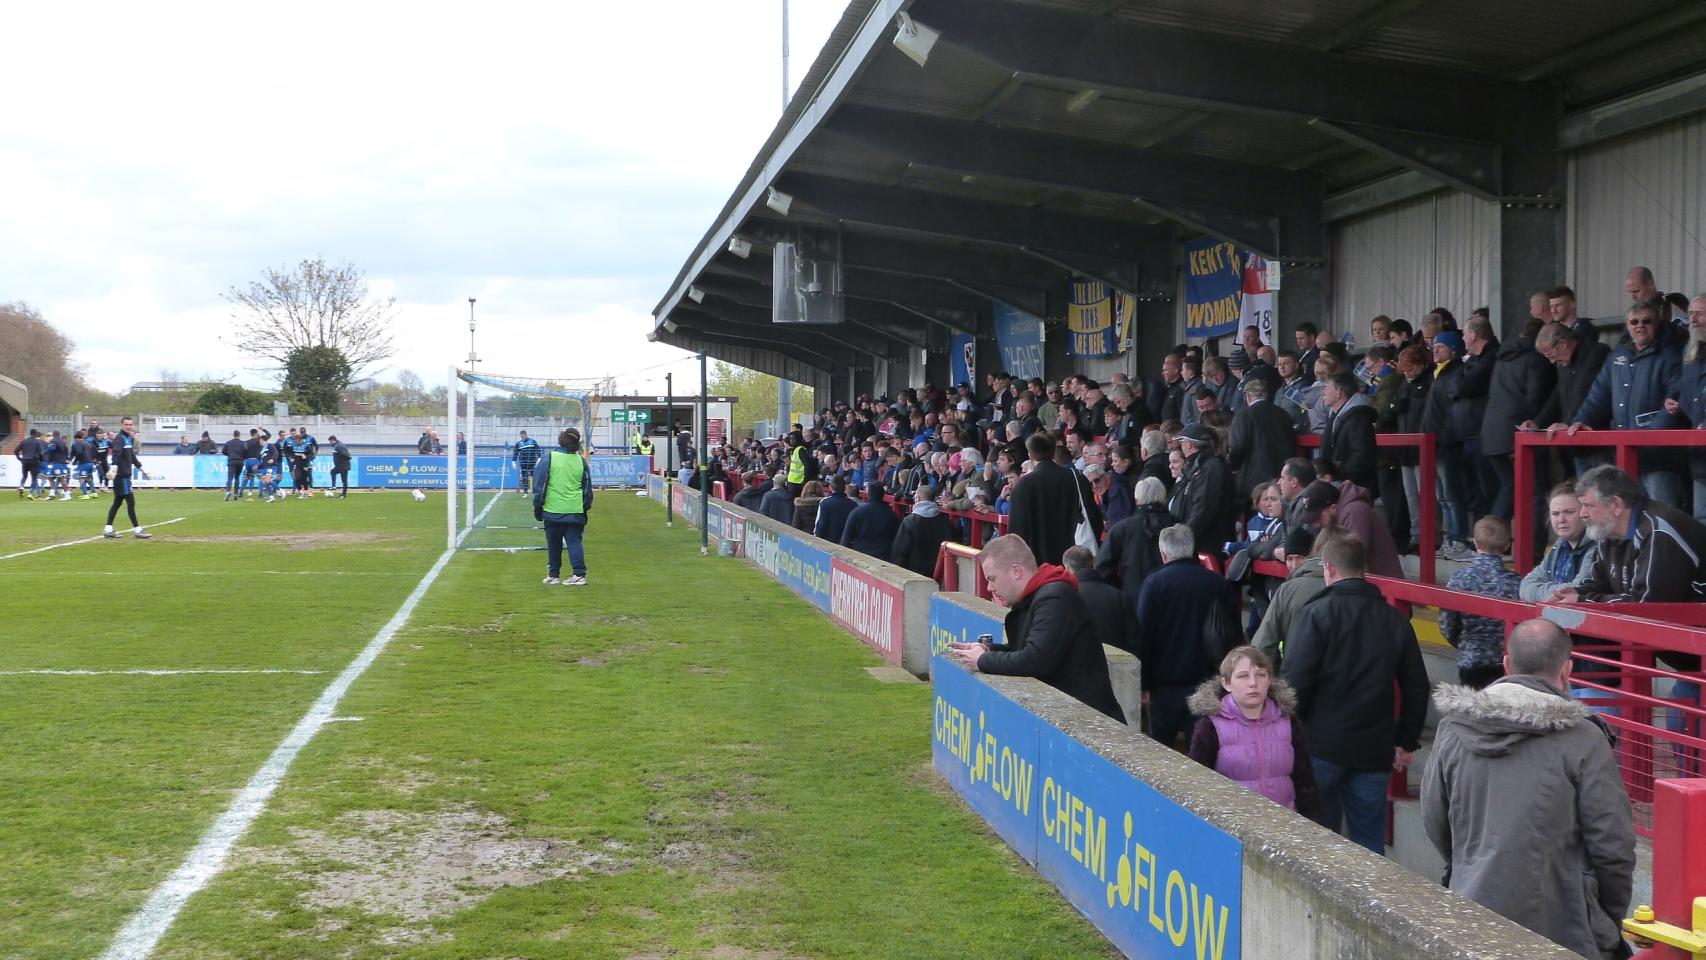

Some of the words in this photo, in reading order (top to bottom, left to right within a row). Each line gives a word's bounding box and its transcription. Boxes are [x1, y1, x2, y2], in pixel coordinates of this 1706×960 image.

[1189, 243, 1224, 276] KENT
[1187, 291, 1241, 329] WOMBL
[831, 566, 893, 652] CHERRYRED.CO.UK
[935, 696, 971, 766] CHEM
[985, 732, 1034, 816] FLOW
[1042, 776, 1107, 882] CHEM
[1134, 842, 1229, 960] FLOW
